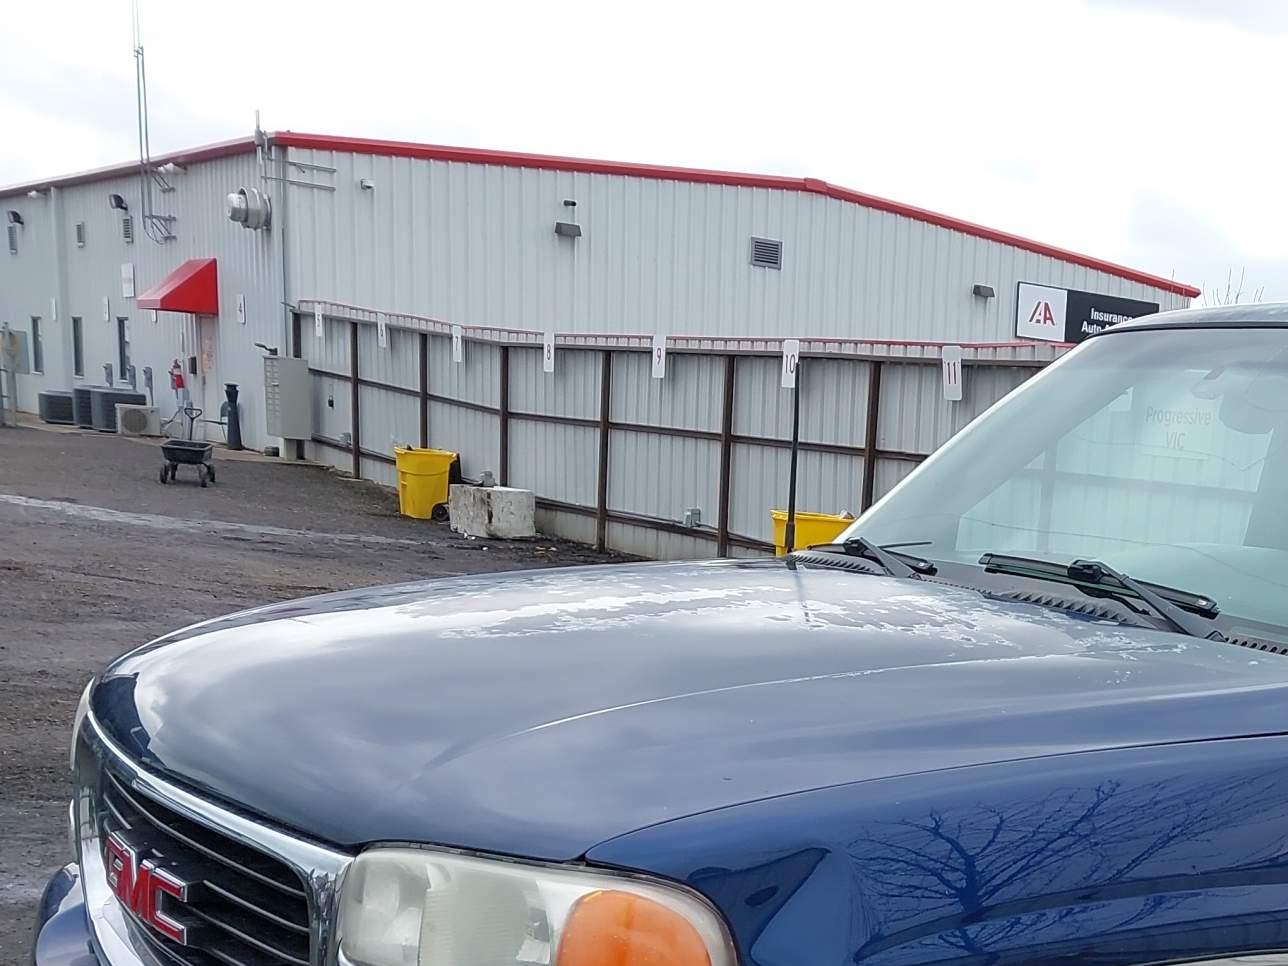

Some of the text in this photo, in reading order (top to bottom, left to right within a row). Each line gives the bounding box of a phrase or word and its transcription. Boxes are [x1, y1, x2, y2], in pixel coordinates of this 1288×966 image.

[455, 336, 460, 350] 7
[546, 343, 551, 361] 8
[656, 347, 662, 365] 9
[784, 353, 796, 375] 10
[946, 361, 957, 385] 11
[1144, 406, 1212, 426] Progressive
[104, 831, 188, 946] GMC
